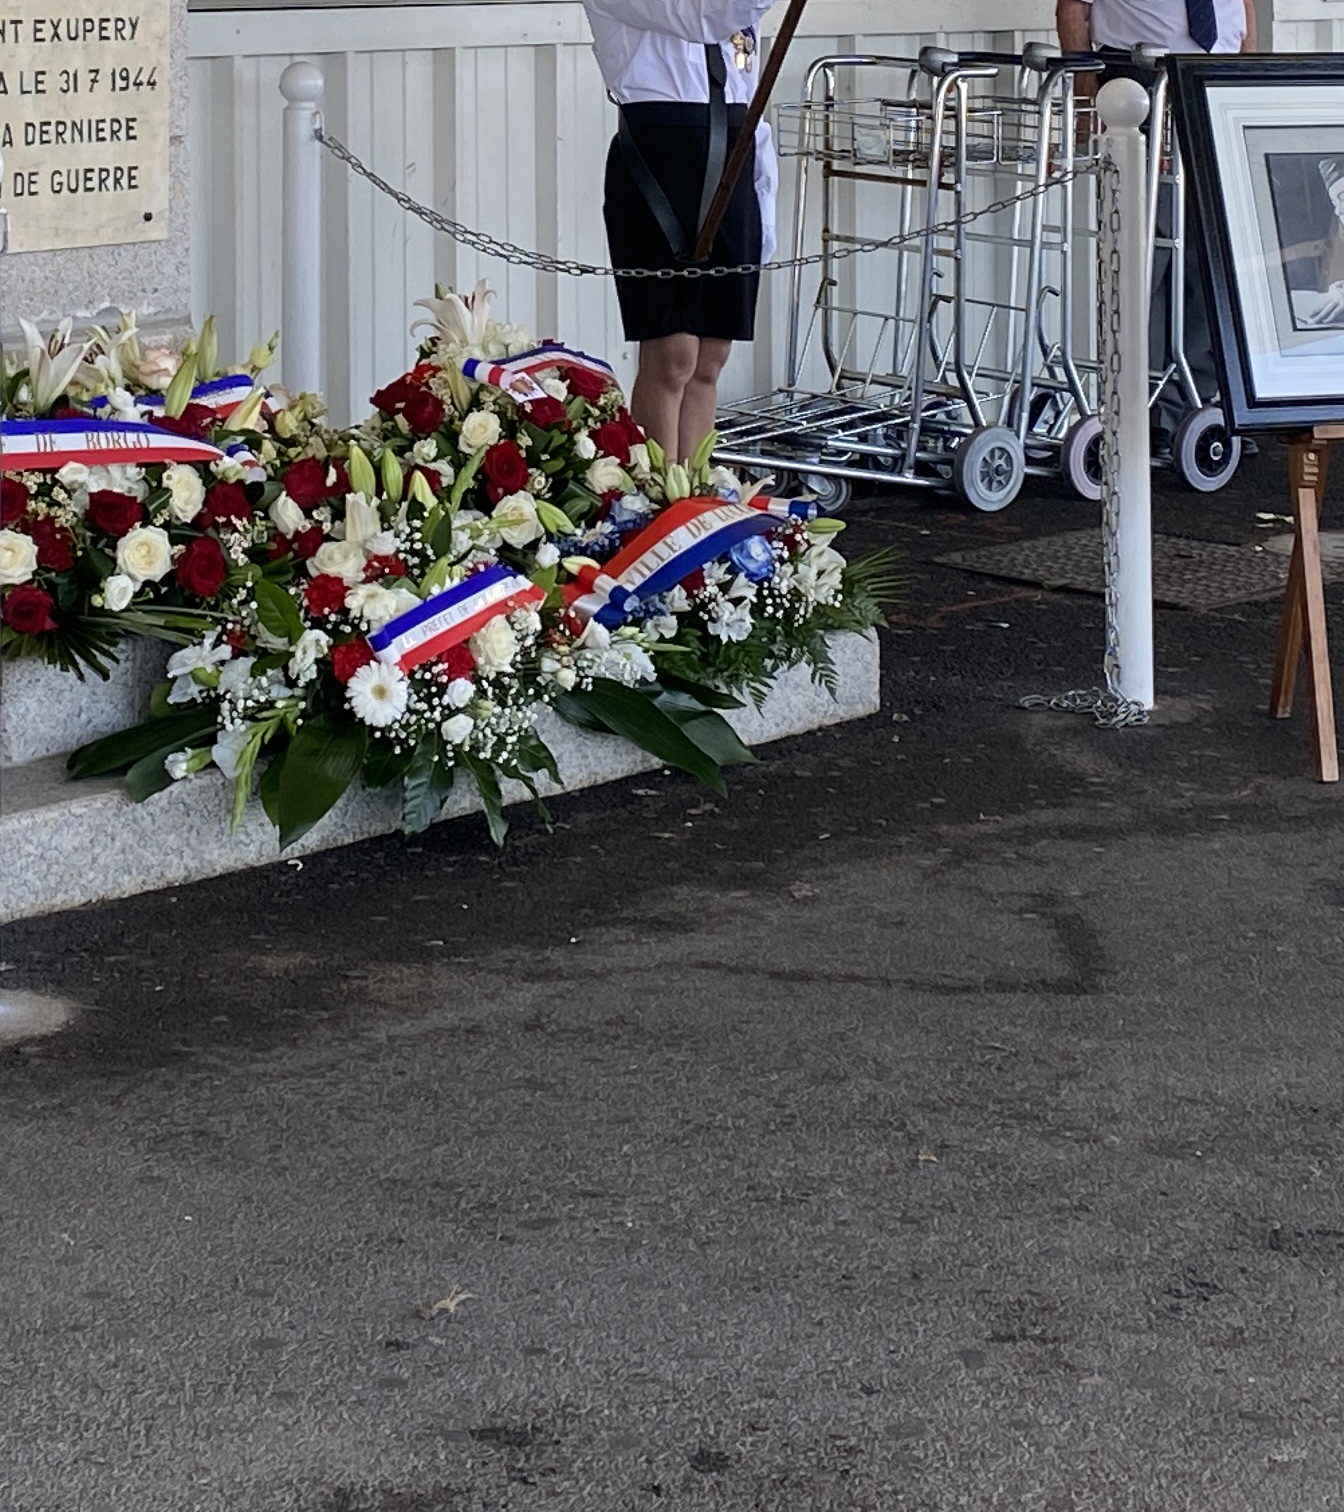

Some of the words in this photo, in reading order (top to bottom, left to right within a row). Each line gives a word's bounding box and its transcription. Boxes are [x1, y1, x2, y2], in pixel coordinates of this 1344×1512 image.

[32, 15, 141, 43] EXUPERY
[18, 70, 48, 95] LE
[58, 68, 79, 93] 31
[87, 67, 101, 94] 7
[110, 65, 159, 93] 1944
[24, 116, 139, 147] DERNIERE
[12, 170, 40, 197] DE
[49, 165, 140, 195] GUERRE
[624, 535, 682, 587] VILLE
[684, 517, 714, 539] DE
